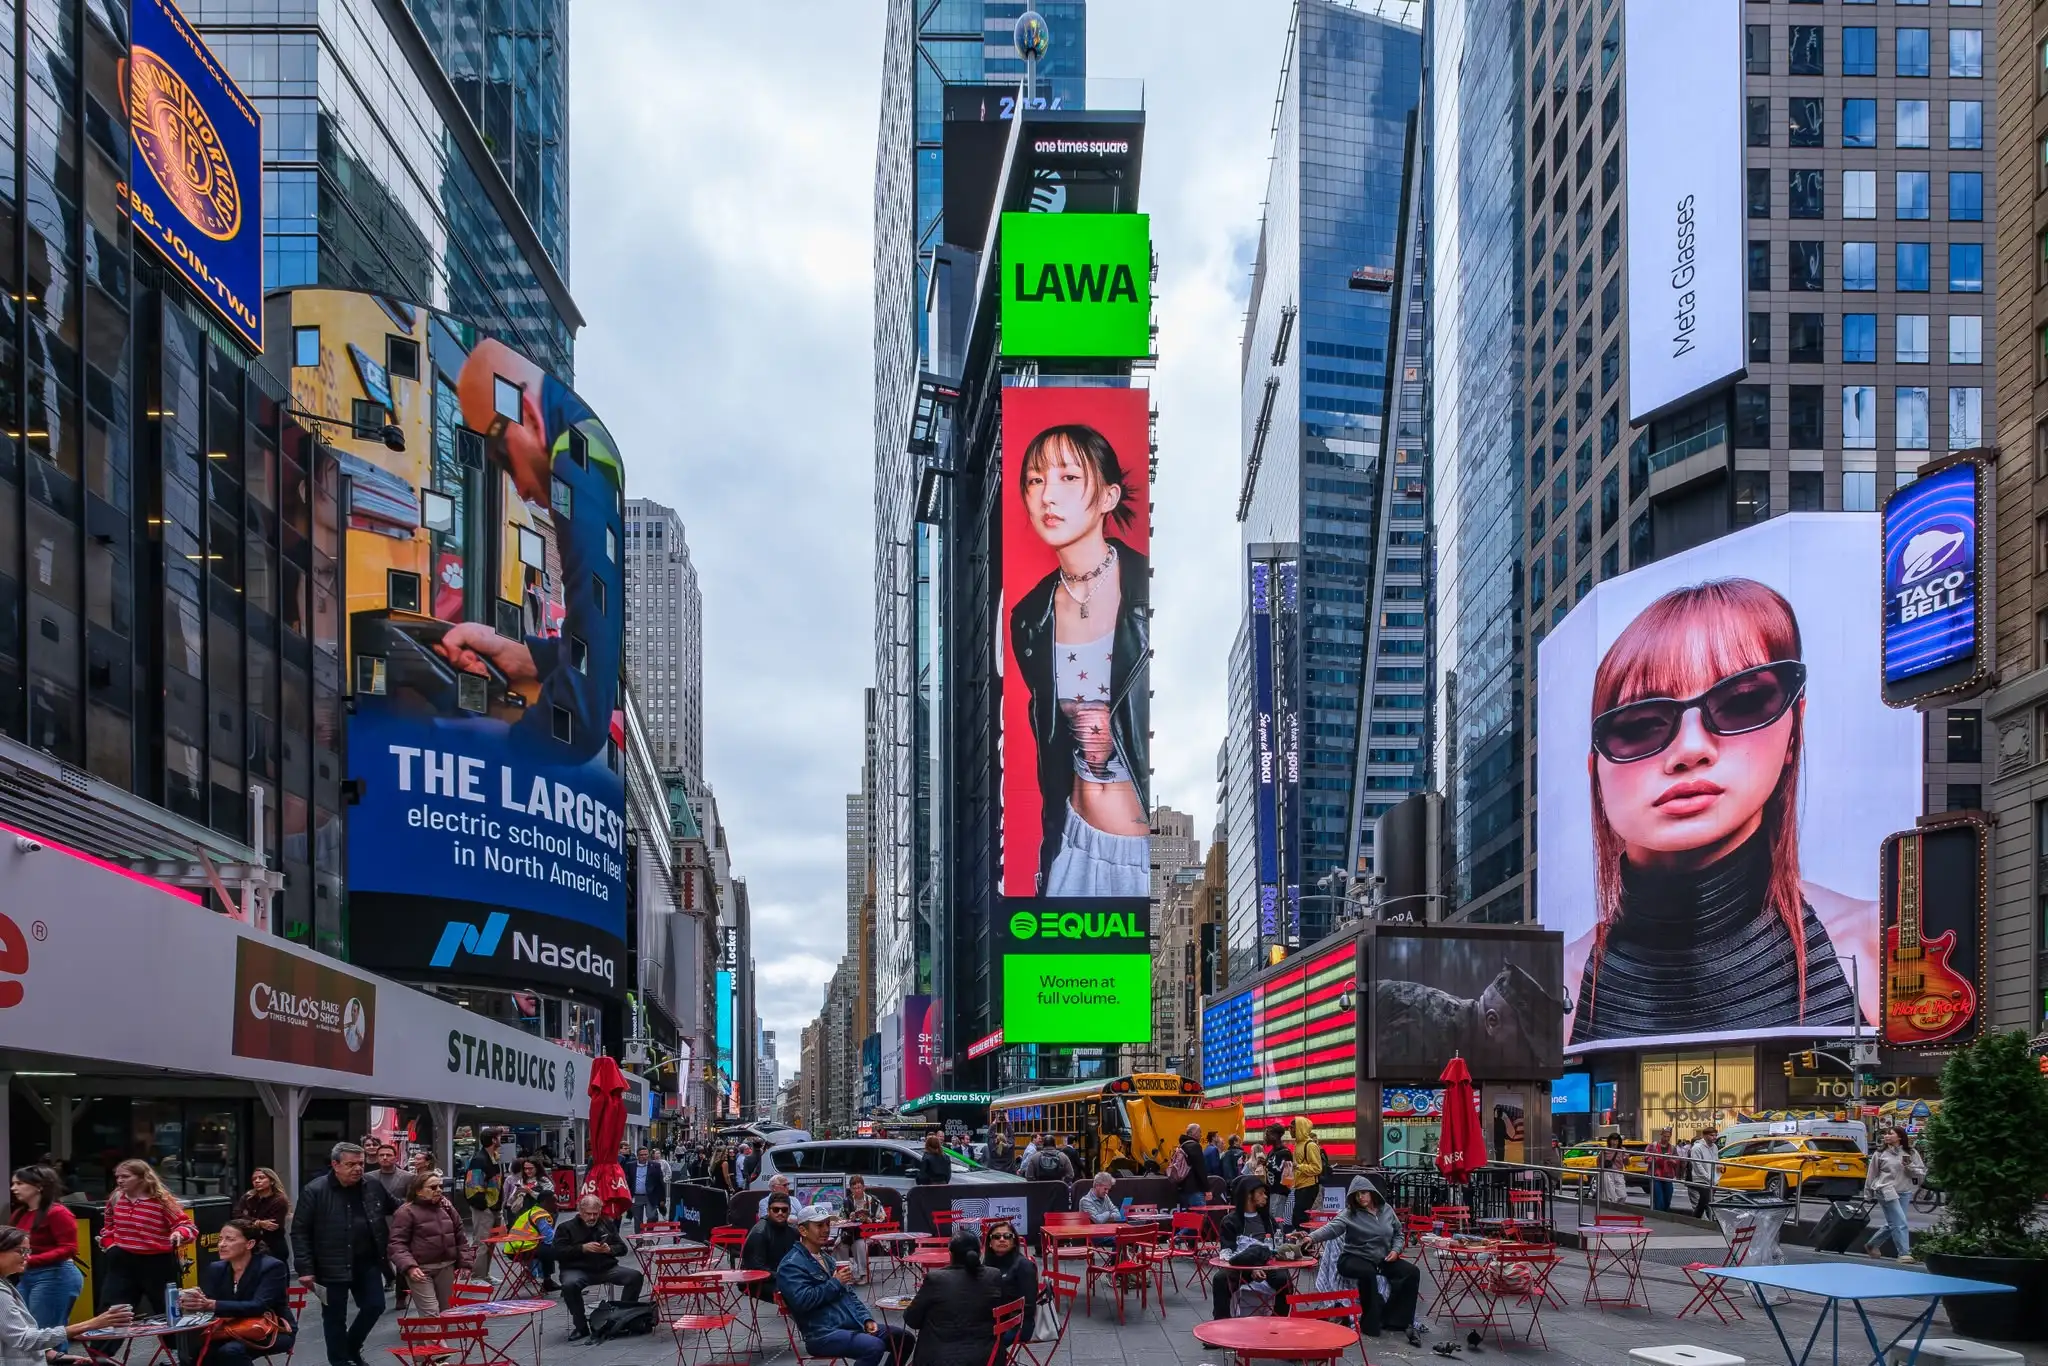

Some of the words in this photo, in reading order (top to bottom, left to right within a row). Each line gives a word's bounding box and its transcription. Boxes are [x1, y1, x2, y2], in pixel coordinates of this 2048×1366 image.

[163, 5, 223, 87] FIGHTBACK
[224, 84, 256, 128] UNION
[187, 98, 235, 222] WORKERS
[1034, 141, 1056, 153] one
[1057, 139, 1089, 153] times
[1089, 141, 1128, 157] square
[1671, 194, 1695, 290] Glasses
[1015, 262, 1139, 303] LAWA
[1672, 289, 1696, 359] Meta
[1896, 571, 1965, 608] TACO
[1901, 589, 1966, 624] BELL
[389, 744, 486, 803] THE
[501, 765, 625, 855] LARGEST
[407, 804, 501, 839] electric
[508, 825, 571, 859] school
[576, 840, 601, 869] bus
[603, 854, 622, 883] fleet
[454, 840, 475, 866] in
[485, 846, 544, 880] North
[550, 862, 609, 901] America
[1041, 912, 1145, 939] EQUAL
[512, 931, 614, 988] Nasdaq
[726, 929, 737, 966] Locker
[1037, 992, 1060, 1004] full
[1061, 992, 1120, 1004] volume.
[1039, 975, 1098, 988] Women
[1100, 976, 1115, 988] at
[269, 1012, 286, 1022] TIMES
[287, 1016, 309, 1028] SQUARE
[319, 1012, 340, 1026] SHOP
[320, 999, 340, 1014] BAKE
[1892, 1000, 1931, 1016] Hard
[1932, 998, 1971, 1016] Rock
[447, 1029, 556, 1093] STARBUCKS
[934, 1092, 968, 1103] Square
[1137, 1079, 1161, 1090] SCHOOL
[1163, 1079, 1178, 1090] BUS
[1668, 1110, 1726, 1122] TOURO
[996, 1205, 1021, 1213] Times
